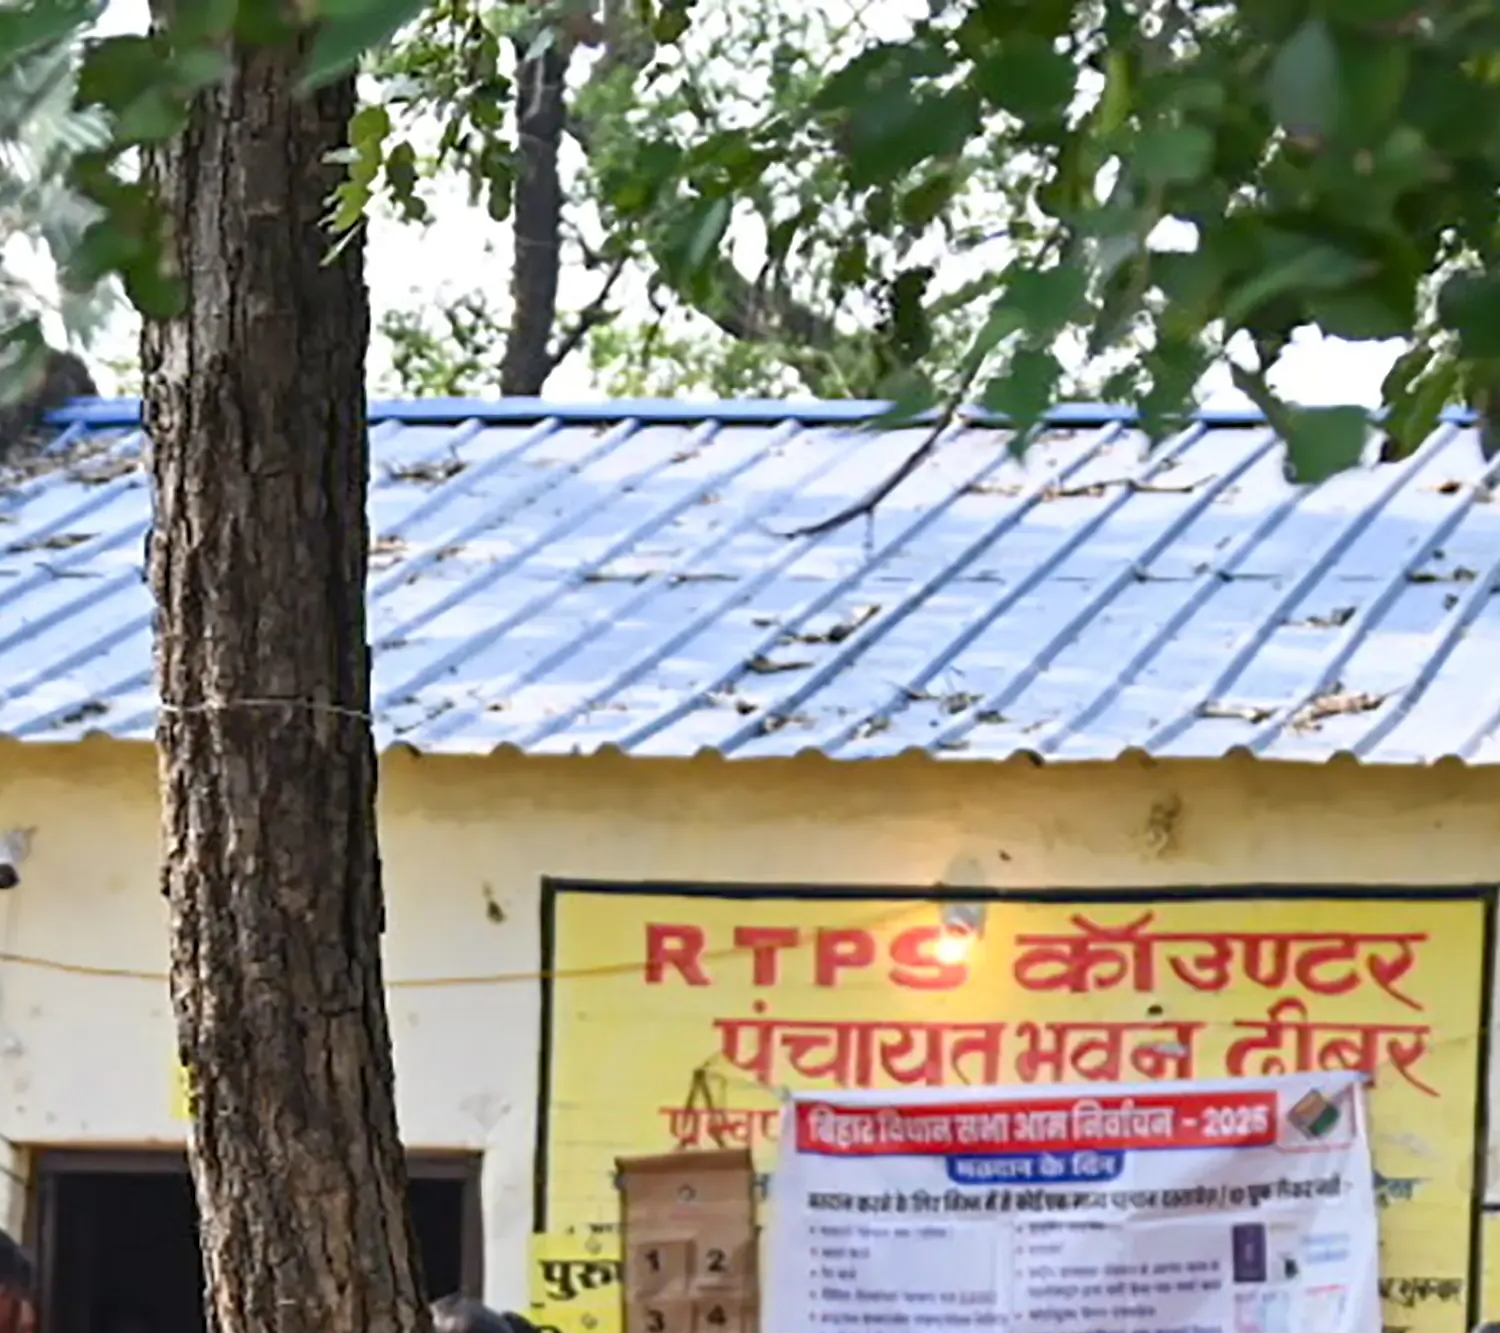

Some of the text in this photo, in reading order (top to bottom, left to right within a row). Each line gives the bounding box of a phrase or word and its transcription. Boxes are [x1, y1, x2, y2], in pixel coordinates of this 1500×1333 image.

[713, 1000, 1006, 1086] पंचायत
[809, 1102, 875, 1148] बिहार
[876, 1106, 953, 1144] विधान
[954, 1112, 1008, 1144] सभा
[1073, 1098, 1174, 1140] निर्वाचन
[539, 1259, 624, 1301] पुरु
[707, 1248, 727, 1273] 2
[646, 1304, 727, 1333] 3 4
